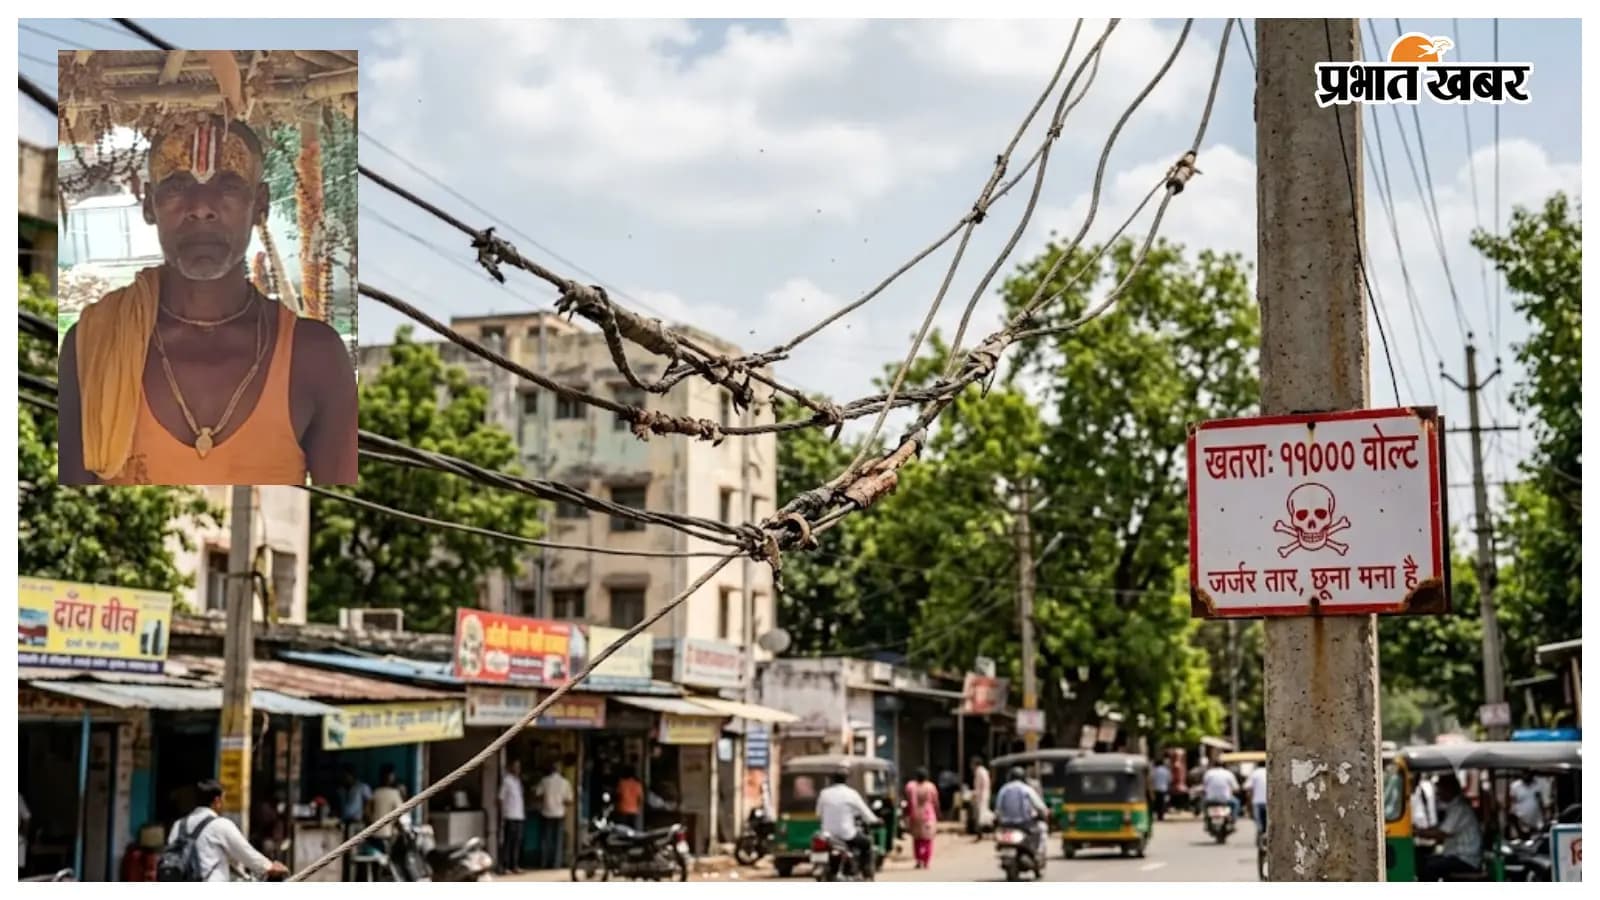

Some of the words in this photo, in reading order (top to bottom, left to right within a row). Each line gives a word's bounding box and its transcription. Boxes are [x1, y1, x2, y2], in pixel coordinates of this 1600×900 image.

[1204, 444, 1274, 479] खतरा:
[1361, 423, 1419, 471] वोल्ट
[1208, 561, 1257, 594] जर्जर
[1263, 568, 1304, 596] तार,
[1310, 567, 1351, 600] छूना
[1358, 565, 1396, 590] मना
[1403, 554, 1419, 590] है
